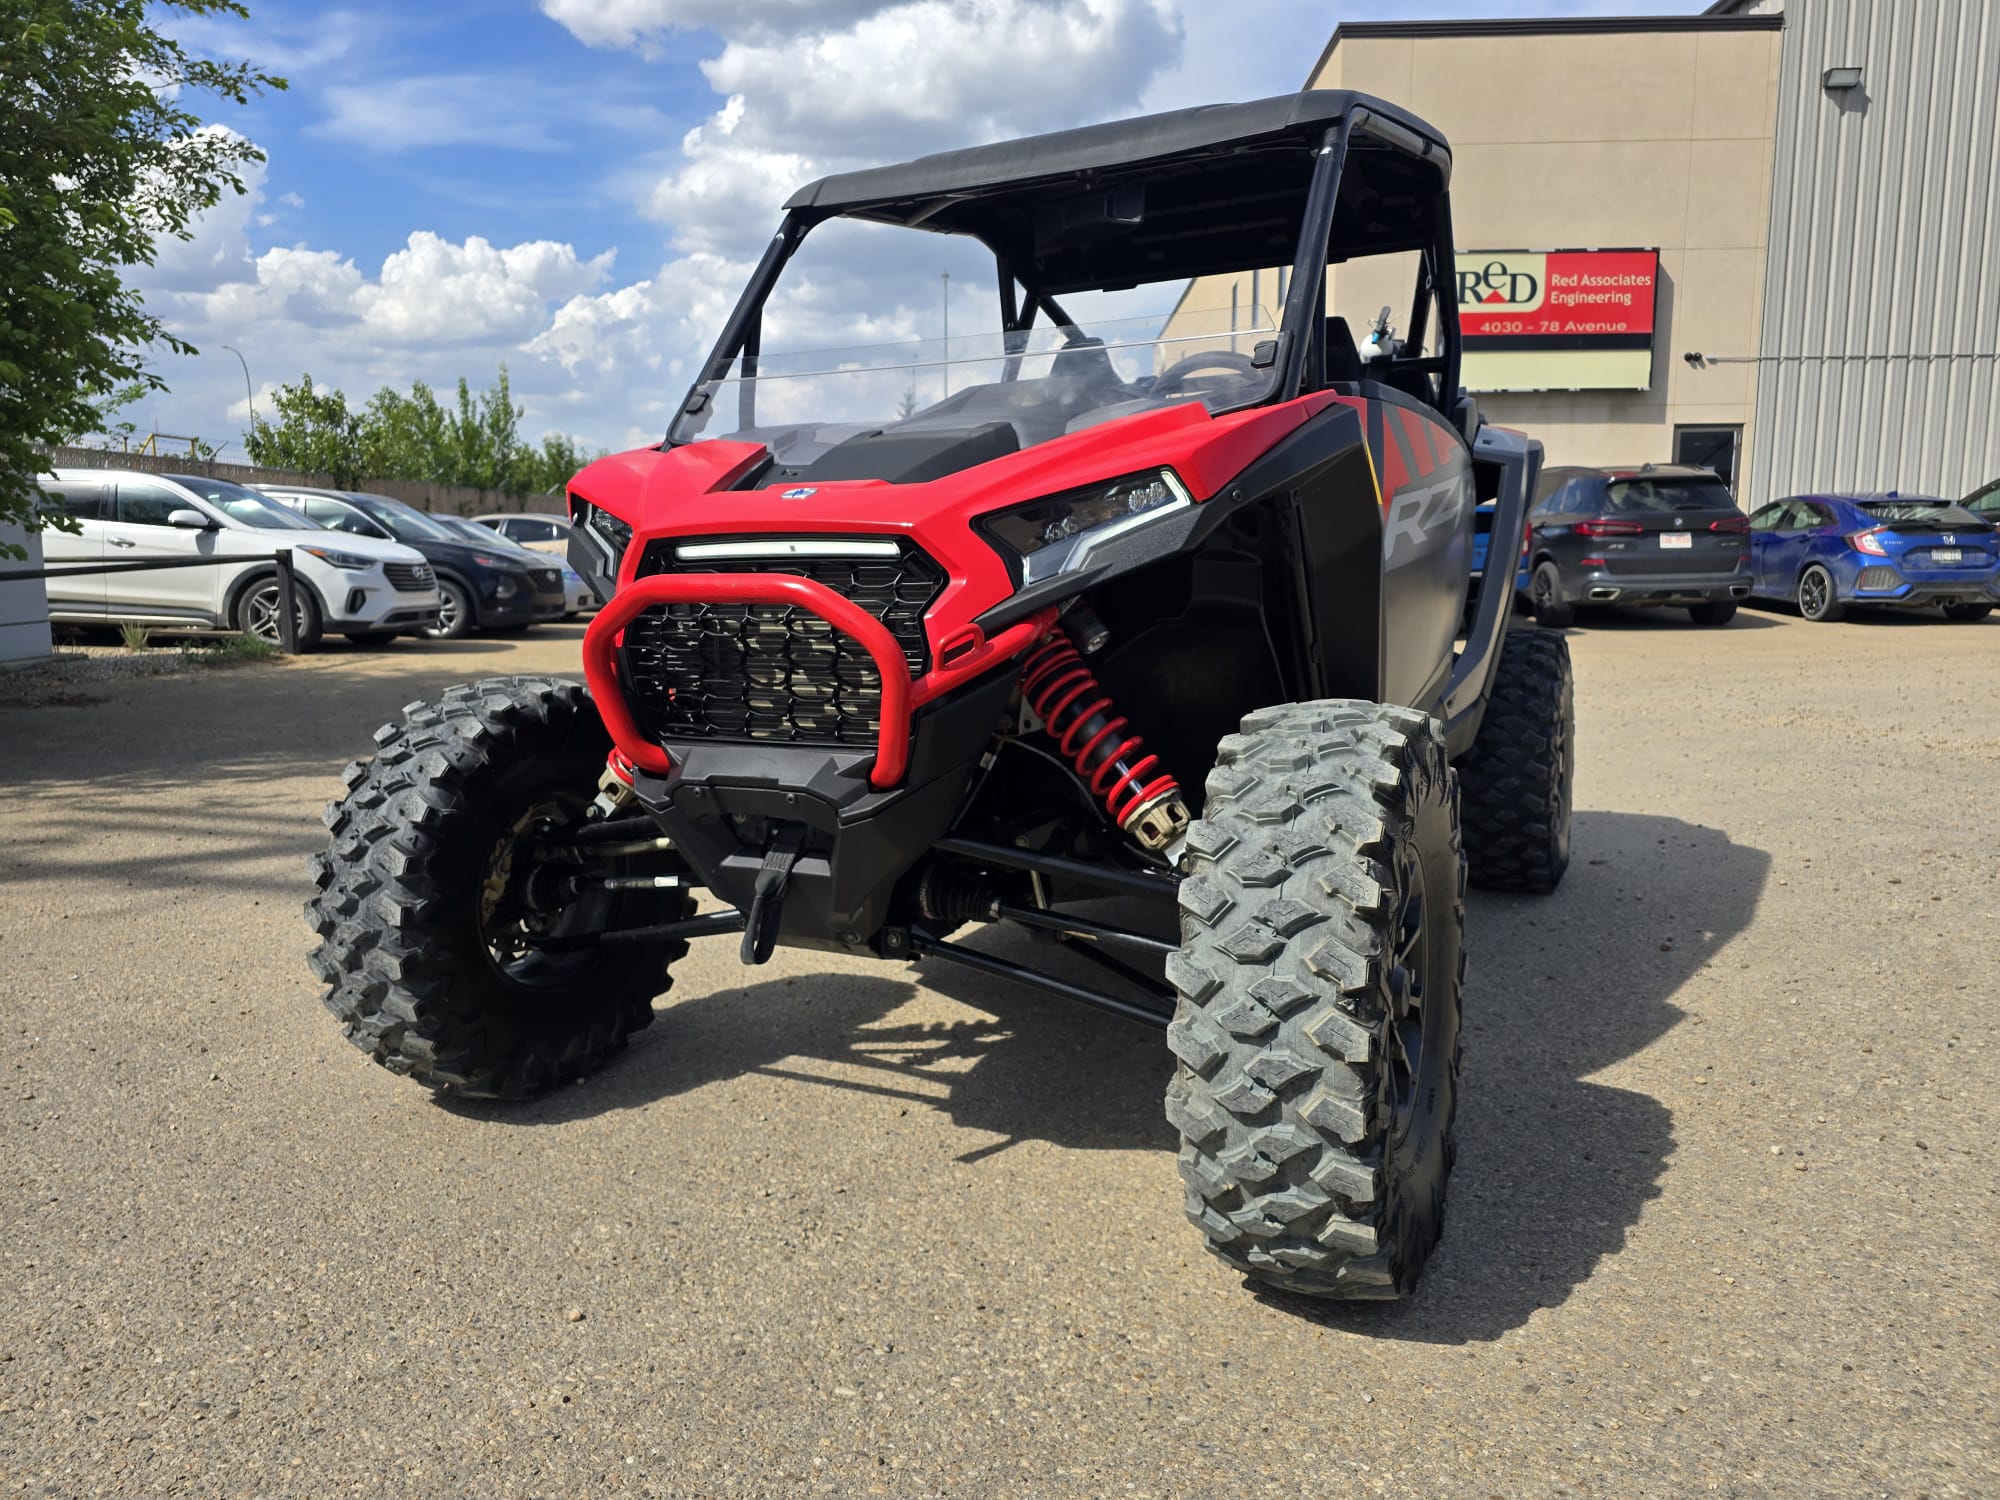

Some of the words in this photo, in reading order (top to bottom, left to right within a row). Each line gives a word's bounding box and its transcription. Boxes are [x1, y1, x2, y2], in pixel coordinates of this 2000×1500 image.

[1551, 274, 1577, 287] Red
[1581, 273, 1652, 287] Associates
[1550, 291, 1632, 306] Engineering
[1480, 321, 1523, 333] 4030
[1540, 321, 1560, 332] 78
[1564, 320, 1628, 332] Avenue
[1384, 474, 1464, 562] RZ
